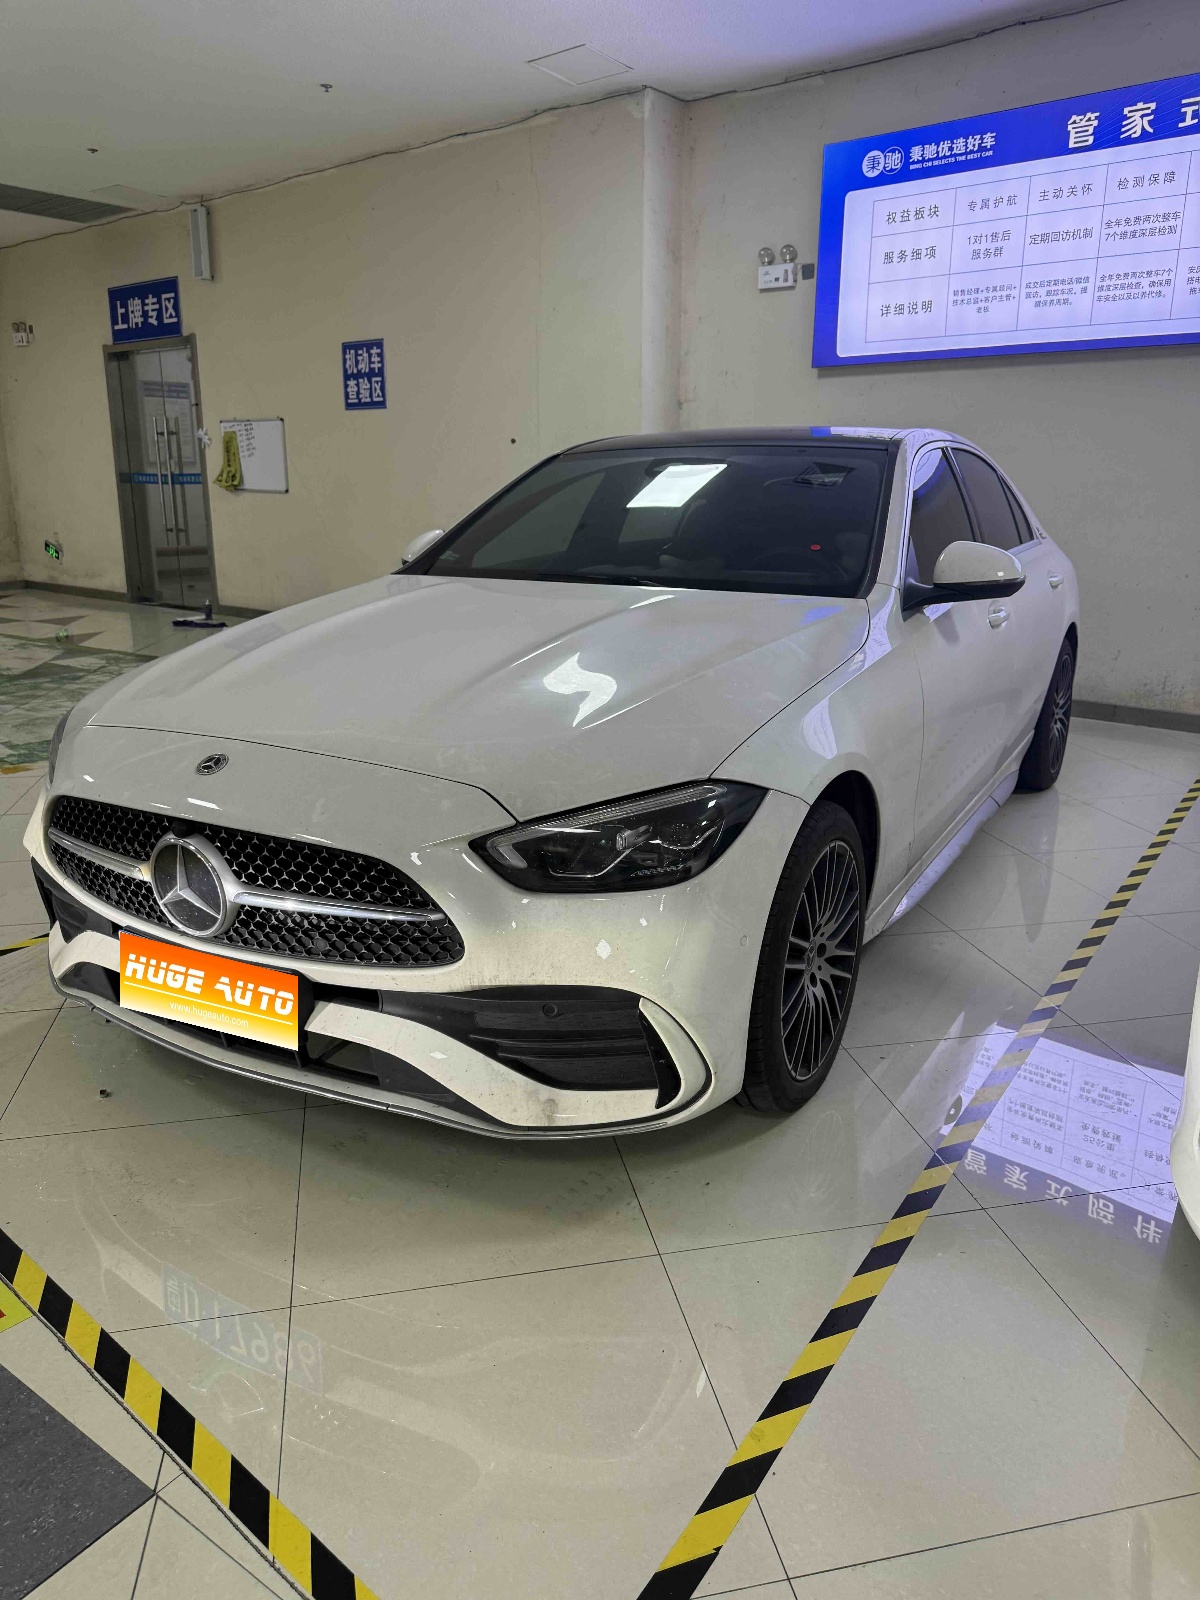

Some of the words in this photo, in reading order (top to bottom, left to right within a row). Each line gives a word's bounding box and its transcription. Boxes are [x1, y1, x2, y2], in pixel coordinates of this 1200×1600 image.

[909, 132, 996, 162] 秉驰优选好车
[933, 156, 955, 166] SELECTS
[956, 154, 967, 162] THE
[967, 152, 981, 160] BEST
[1117, 171, 1176, 190] 检测保障
[1039, 183, 1093, 201] 主动关怀
[968, 194, 1017, 211] 专属护航
[886, 204, 940, 225] 权益板块
[1104, 211, 1181, 229] 全年免费两次整车
[967, 230, 1011, 245] 1对1售后
[1029, 227, 1093, 245] 定期回访机制
[1105, 224, 1177, 242] 7个维度深层检测
[883, 246, 937, 265] 服务细项
[971, 246, 1004, 260] 服务群
[114, 292, 178, 331] 上牌专区
[880, 300, 933, 317] 详细说明
[976, 305, 990, 313] 老板
[345, 346, 382, 375] 机动车
[346, 377, 384, 405] 查验区
